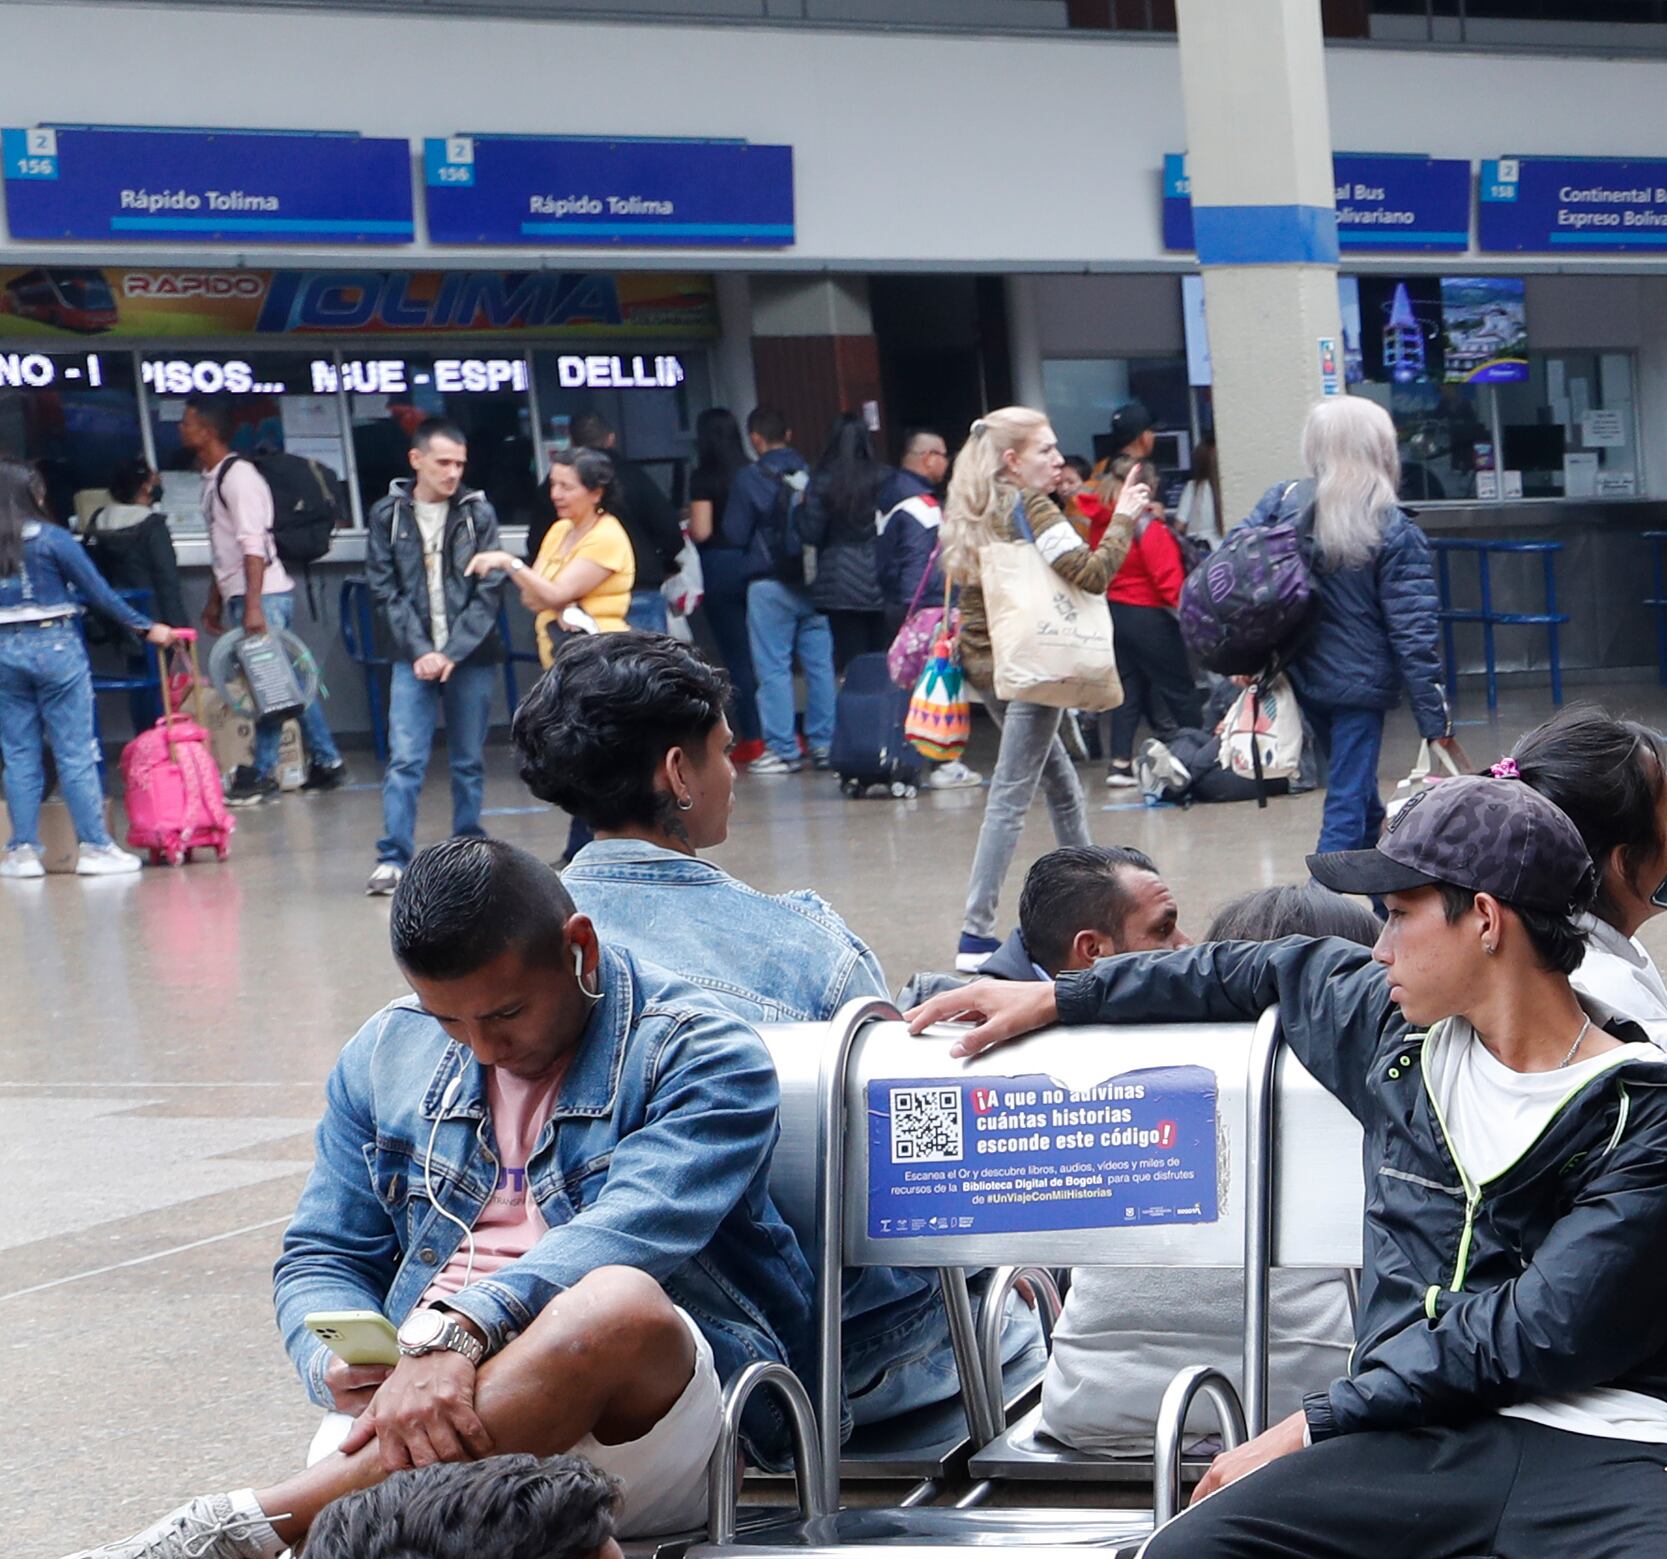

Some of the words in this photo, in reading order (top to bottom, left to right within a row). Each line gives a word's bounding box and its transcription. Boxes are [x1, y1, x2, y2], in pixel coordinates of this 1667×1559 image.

[35, 136, 47, 148] 2
[454, 145, 465, 157] 2
[17, 159, 53, 174] 156
[437, 167, 470, 182] 156
[1504, 166, 1514, 177] 2
[120, 189, 201, 213] Rápido
[204, 191, 280, 211] Tolima
[1354, 185, 1385, 200] Bus
[1558, 187, 1651, 203] Continental
[529, 194, 602, 218] Rápido
[606, 196, 675, 215] Tolima
[1557, 209, 1620, 229] Expreso
[123, 272, 265, 300] RAPIDO
[255, 269, 624, 333] TOLIMA
[976, 1089, 999, 1111] ¡A
[1004, 1091, 1036, 1109] que
[1042, 1088, 1064, 1105] no
[1069, 1083, 1146, 1103] adivinas
[976, 1110, 1047, 1132] cuántas
[1052, 1107, 1132, 1127] historias
[976, 1133, 1050, 1154] esconde
[1055, 1130, 1095, 1150] este
[1100, 1124, 1171, 1149] código!
[904, 1170, 946, 1182] Escanea
[947, 1170, 957, 1179] el
[972, 1170, 979, 1180] y
[980, 1166, 1026, 1178] descubre
[1028, 1164, 1058, 1176] libros,
[1060, 1162, 1096, 1174] audios,
[1097, 1160, 1129, 1171] vídeos
[1131, 1161, 1137, 1170] y
[1139, 1158, 1165, 1169] miles
[1167, 1156, 1180, 1167] de
[891, 1185, 932, 1195] recursos
[934, 1183, 947, 1193] de
[948, 1183, 958, 1193] la
[962, 1178, 1013, 1192] Biblioteca
[1015, 1177, 1048, 1190] Digital
[1049, 1177, 1062, 1188] de
[1065, 1174, 1103, 1188] Bogotá
[1107, 1173, 1131, 1185] para
[1132, 1172, 1151, 1184] que
[1153, 1170, 1195, 1181] disfrutes
[971, 1195, 985, 1204] de
[987, 1187, 1113, 1204] #UnViajeConMilHistorias
